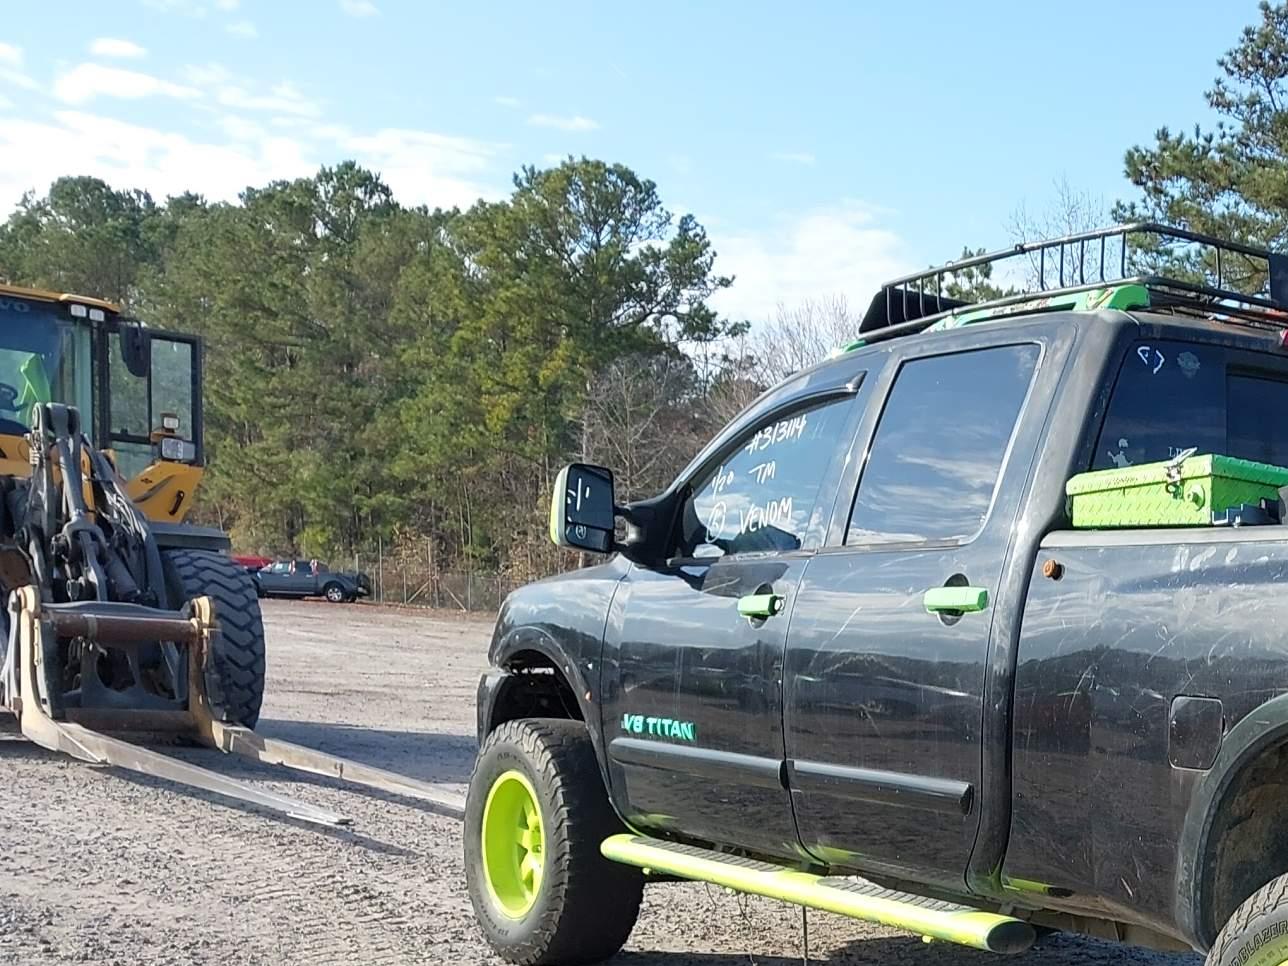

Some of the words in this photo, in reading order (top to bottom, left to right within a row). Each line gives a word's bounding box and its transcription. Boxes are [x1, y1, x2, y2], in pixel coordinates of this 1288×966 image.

[749, 461, 776, 484] TM
[739, 497, 793, 534] VENOM
[622, 713, 644, 733] V8
[646, 717, 696, 741] TITAN
